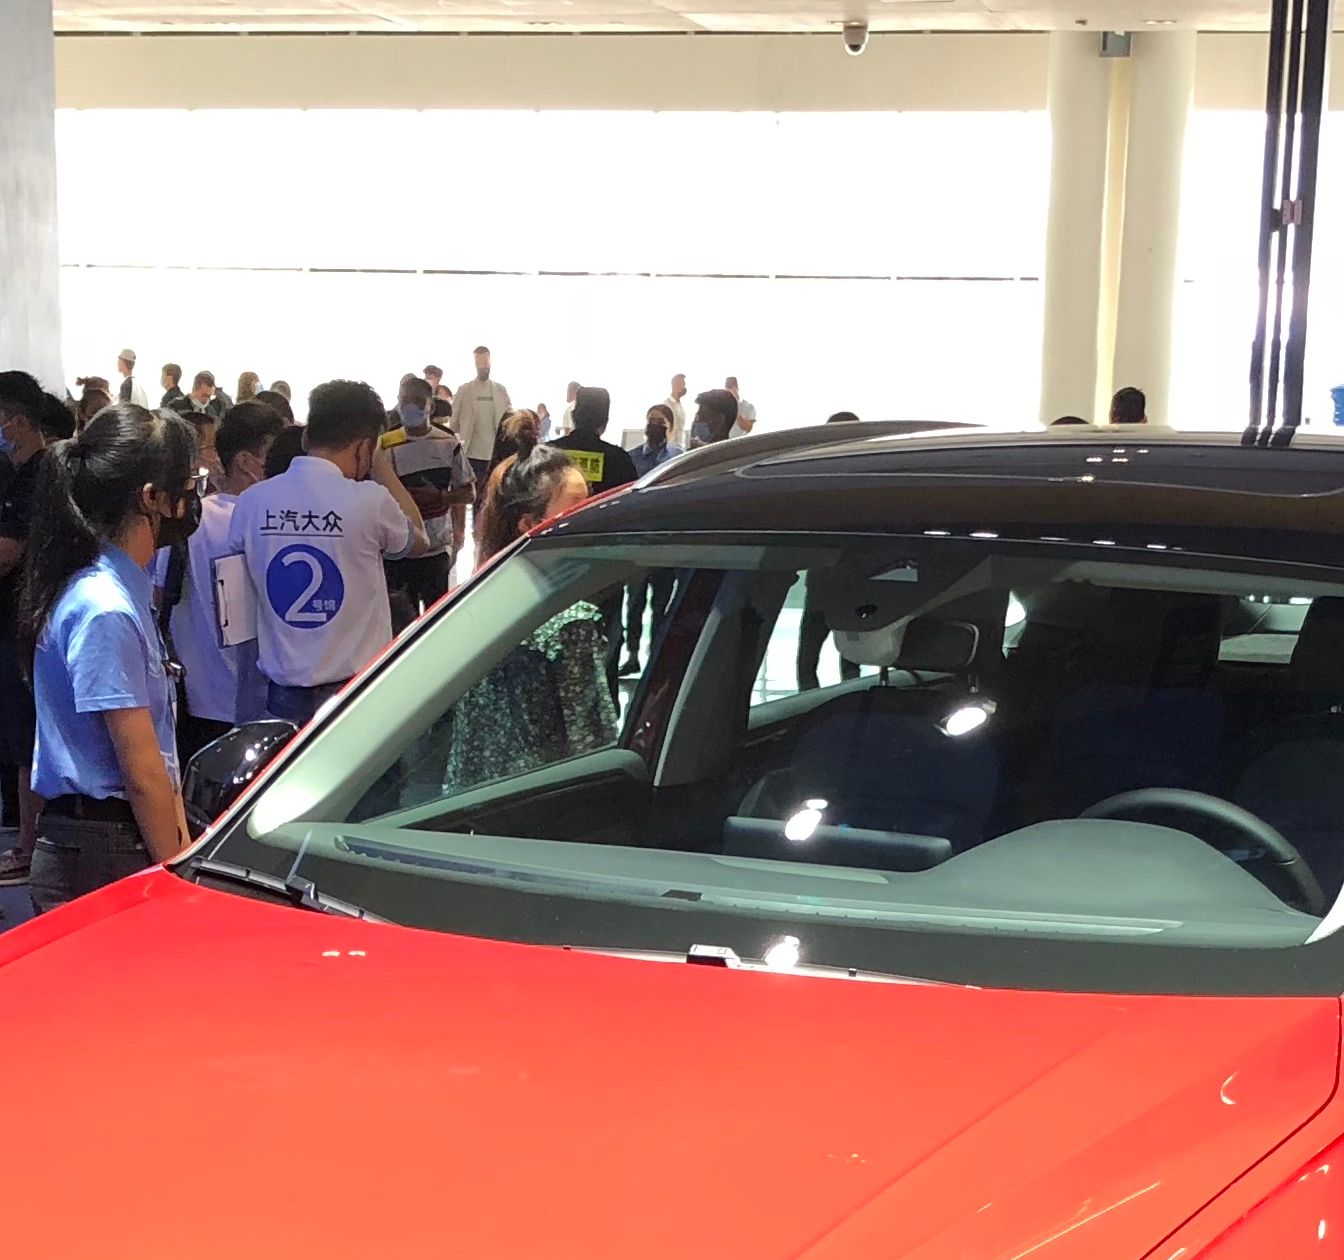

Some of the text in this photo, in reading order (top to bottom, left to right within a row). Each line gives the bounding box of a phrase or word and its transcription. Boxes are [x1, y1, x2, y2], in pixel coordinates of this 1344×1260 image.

[260, 509, 343, 532] 上汽大众
[281, 551, 327, 622] 2
